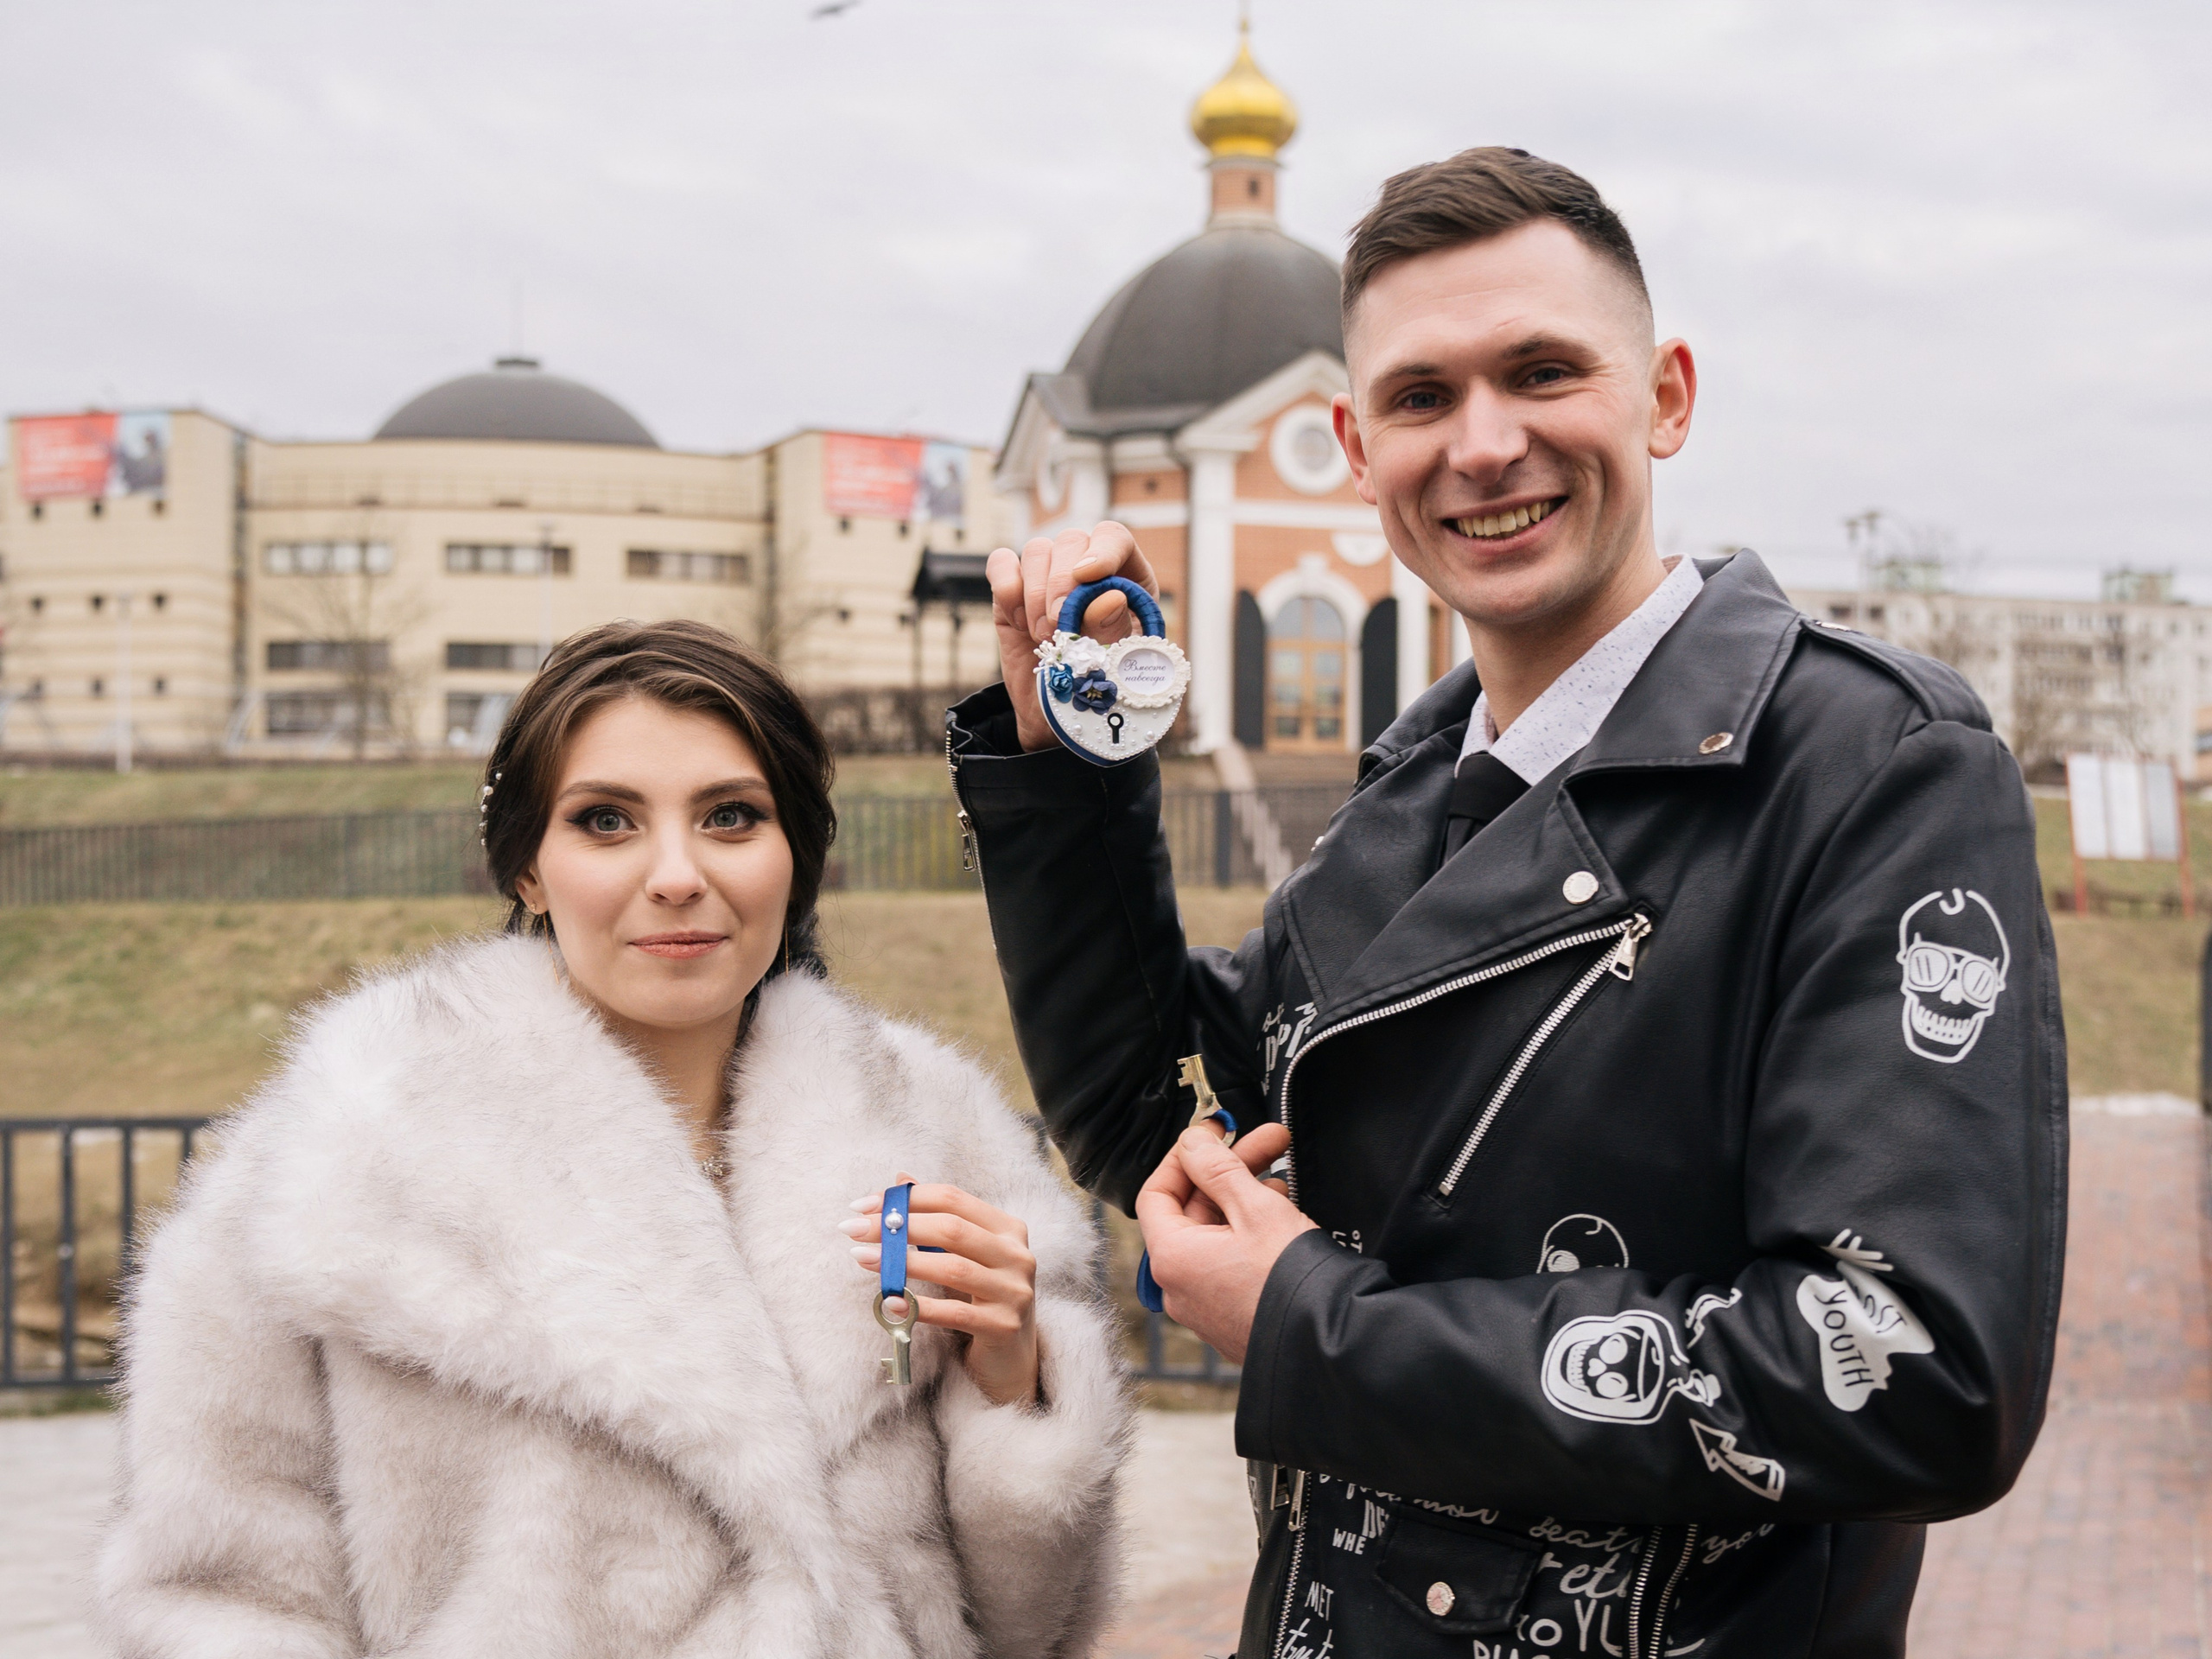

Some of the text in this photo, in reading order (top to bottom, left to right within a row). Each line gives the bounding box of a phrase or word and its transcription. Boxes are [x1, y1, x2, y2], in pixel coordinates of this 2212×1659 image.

[1123, 658, 1166, 671] Вместе
[1124, 671, 1166, 687] навсегда
[1855, 1286, 1907, 1334] OST
[1813, 1289, 1874, 1388] YOUTH
[1304, 1580, 1335, 1622] MET
